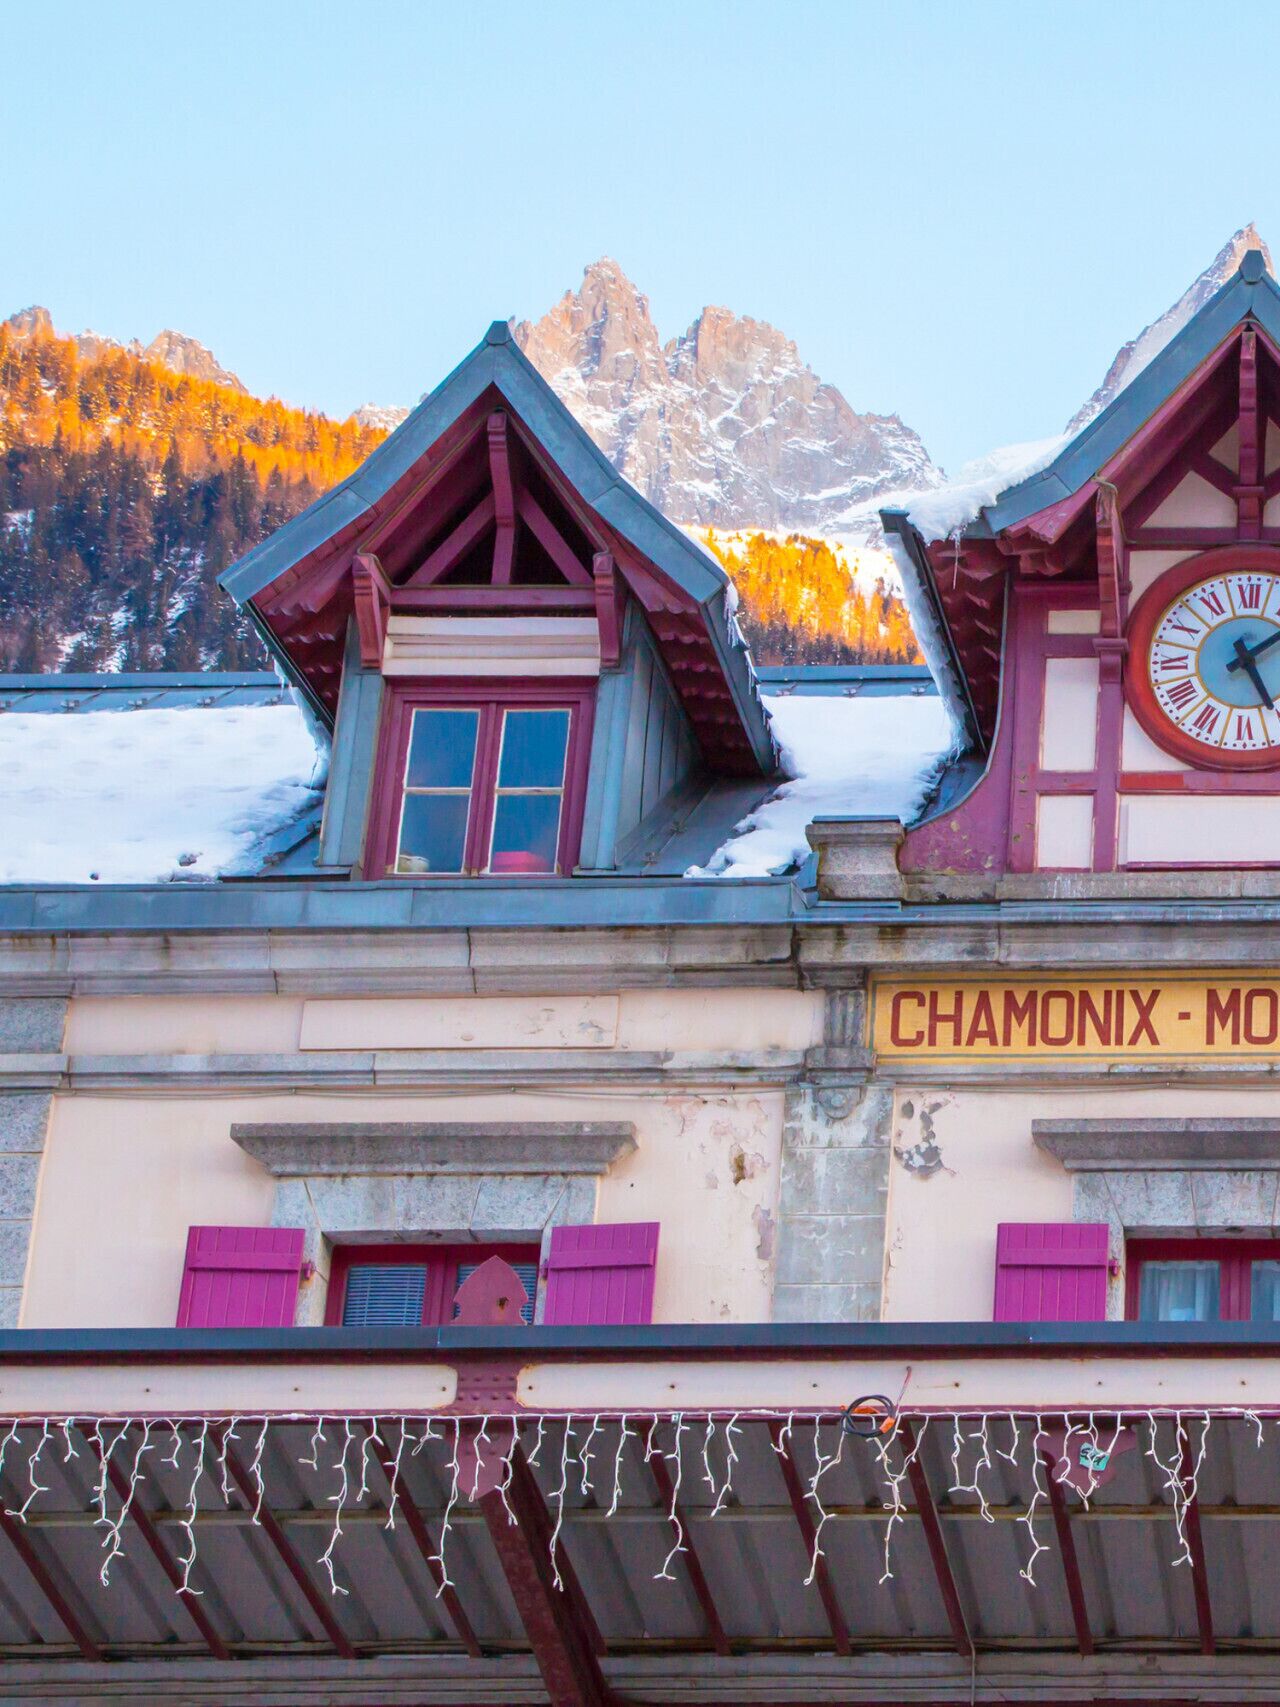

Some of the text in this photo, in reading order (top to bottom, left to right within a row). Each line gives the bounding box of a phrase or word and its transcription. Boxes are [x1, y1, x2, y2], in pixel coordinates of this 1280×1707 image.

[1199, 591, 1226, 620] XI
[1237, 583, 1262, 609] XII
[1171, 617, 1200, 640] X
[890, 989, 1161, 1047] CHAMONIX
